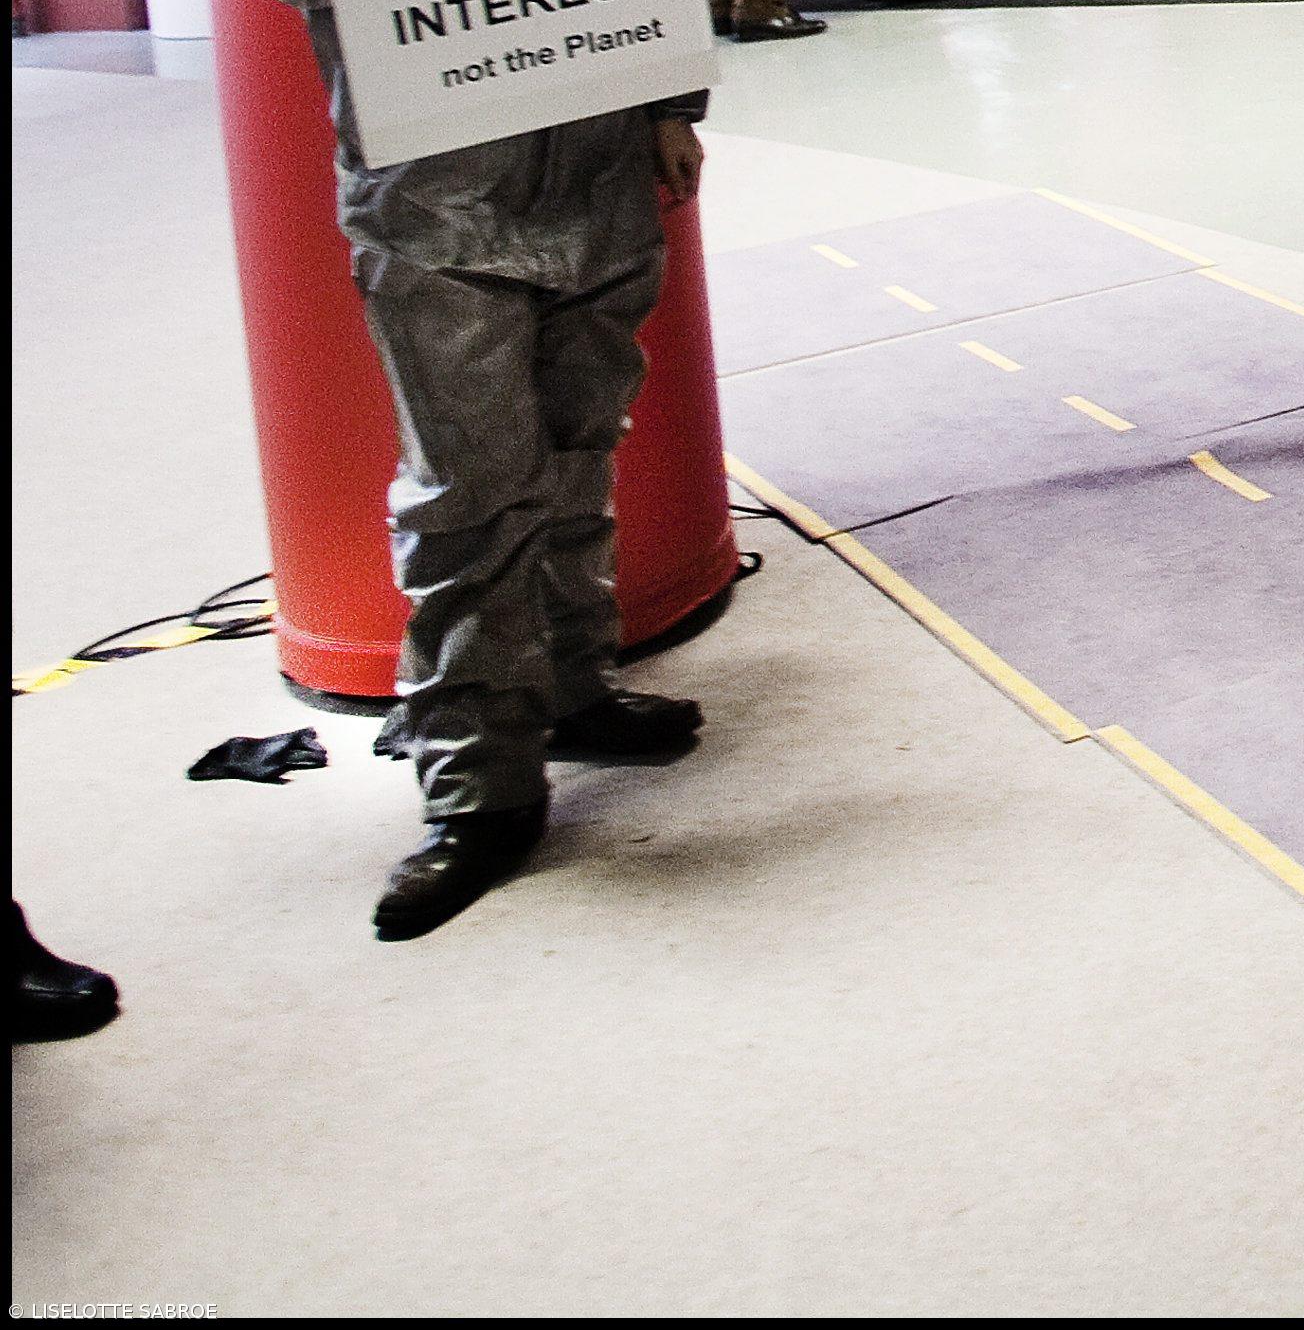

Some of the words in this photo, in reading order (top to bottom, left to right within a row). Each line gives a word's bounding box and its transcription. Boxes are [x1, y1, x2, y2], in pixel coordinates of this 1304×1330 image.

[442, 56, 498, 88] not
[505, 45, 558, 73] the
[565, 18, 667, 60] Planet
